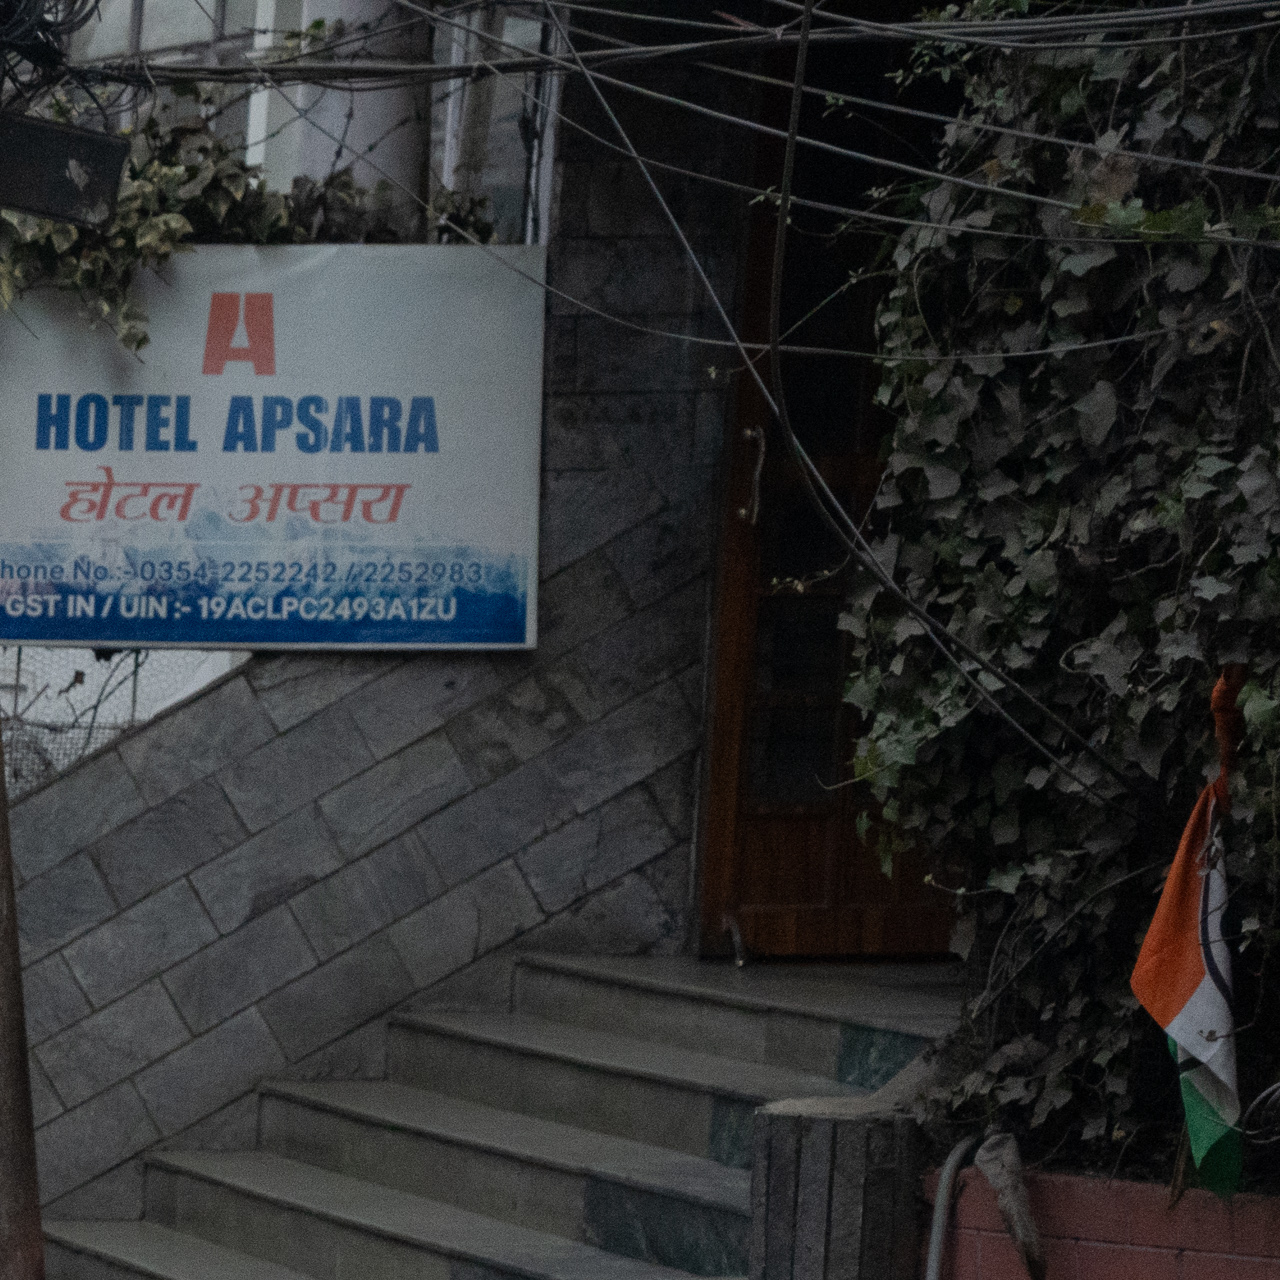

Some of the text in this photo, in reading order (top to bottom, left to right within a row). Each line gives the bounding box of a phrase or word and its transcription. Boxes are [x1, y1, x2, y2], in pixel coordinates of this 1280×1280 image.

[35, 393, 440, 453] HOTEL APSARA
[59, 466, 412, 524] होटल अप्सरा
[364, 561, 482, 583] 2252983
[5, 595, 62, 618] GST
[67, 595, 95, 618] IN
[100, 595, 114, 618] /
[120, 596, 168, 619] UIN
[197, 596, 457, 621] 19ACLPC2493A1ZU
